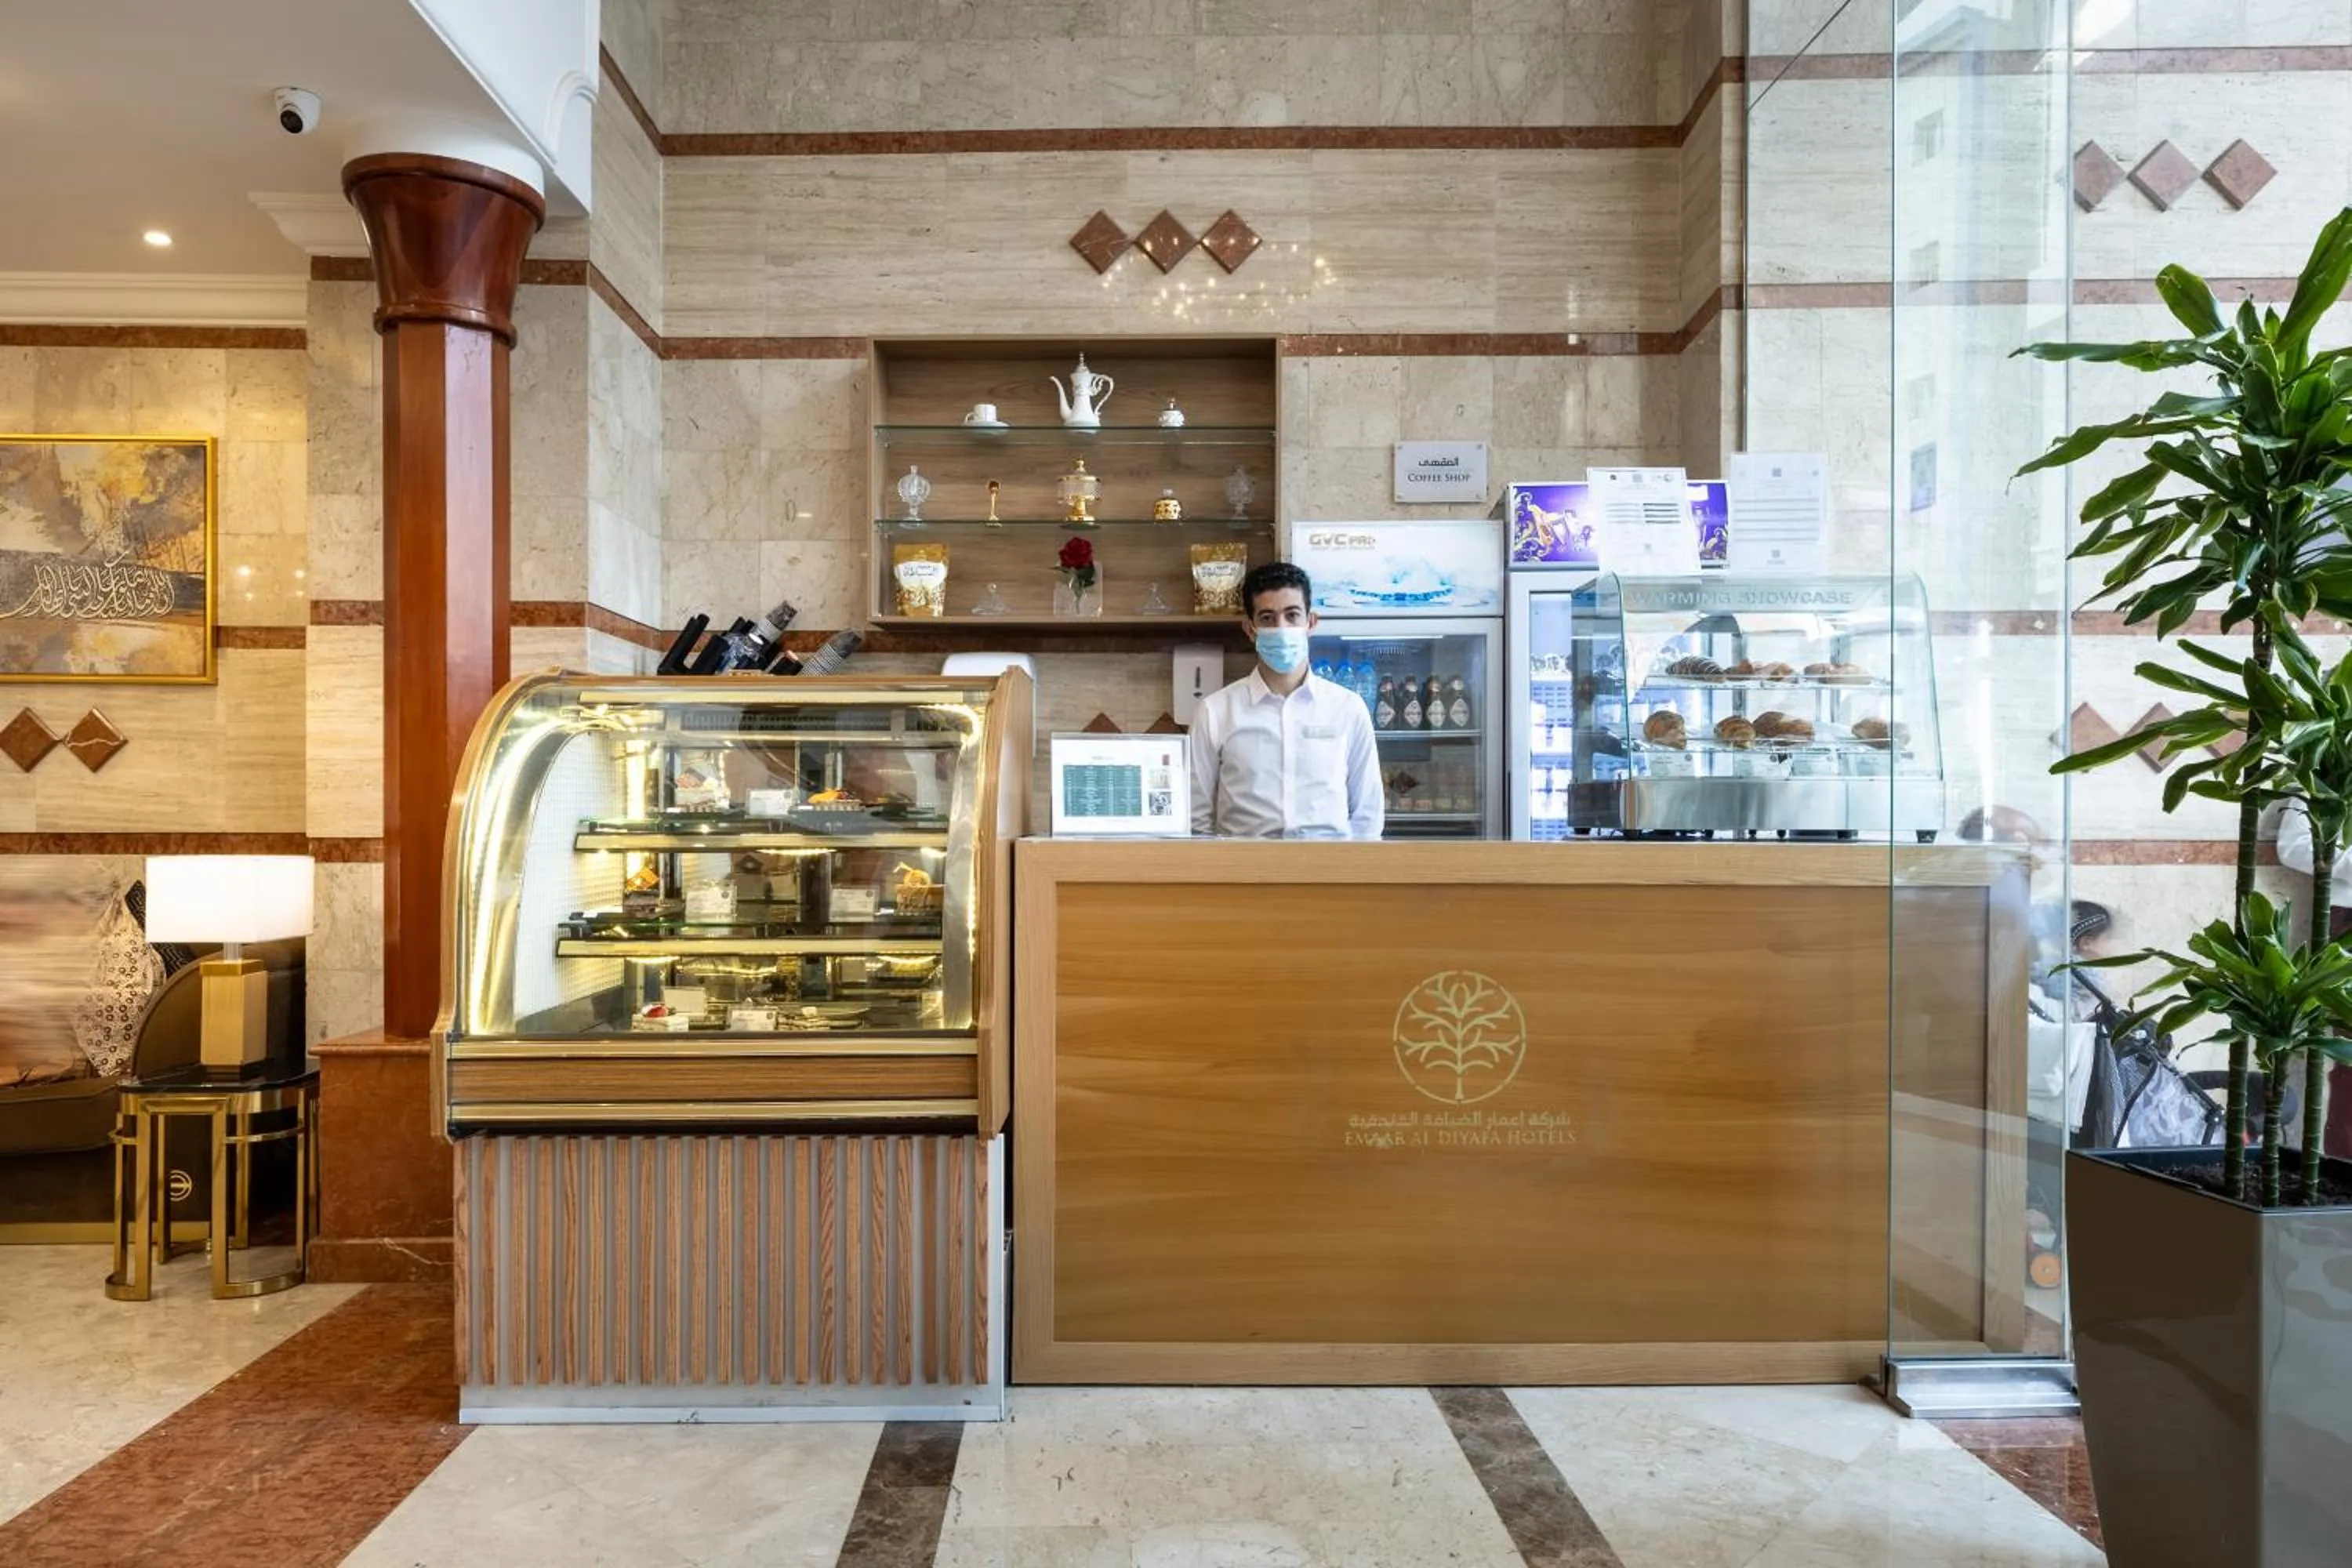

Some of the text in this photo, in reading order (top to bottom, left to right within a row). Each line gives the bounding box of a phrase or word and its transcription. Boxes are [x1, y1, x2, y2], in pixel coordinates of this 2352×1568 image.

[1417, 456, 1459, 466] المقهى
[1407, 473, 1472, 482] COFFEE SHOP
[1630, 590, 1853, 604] WARMING SHOWCASE
[1507, 1129, 1577, 1145] HOTELS
